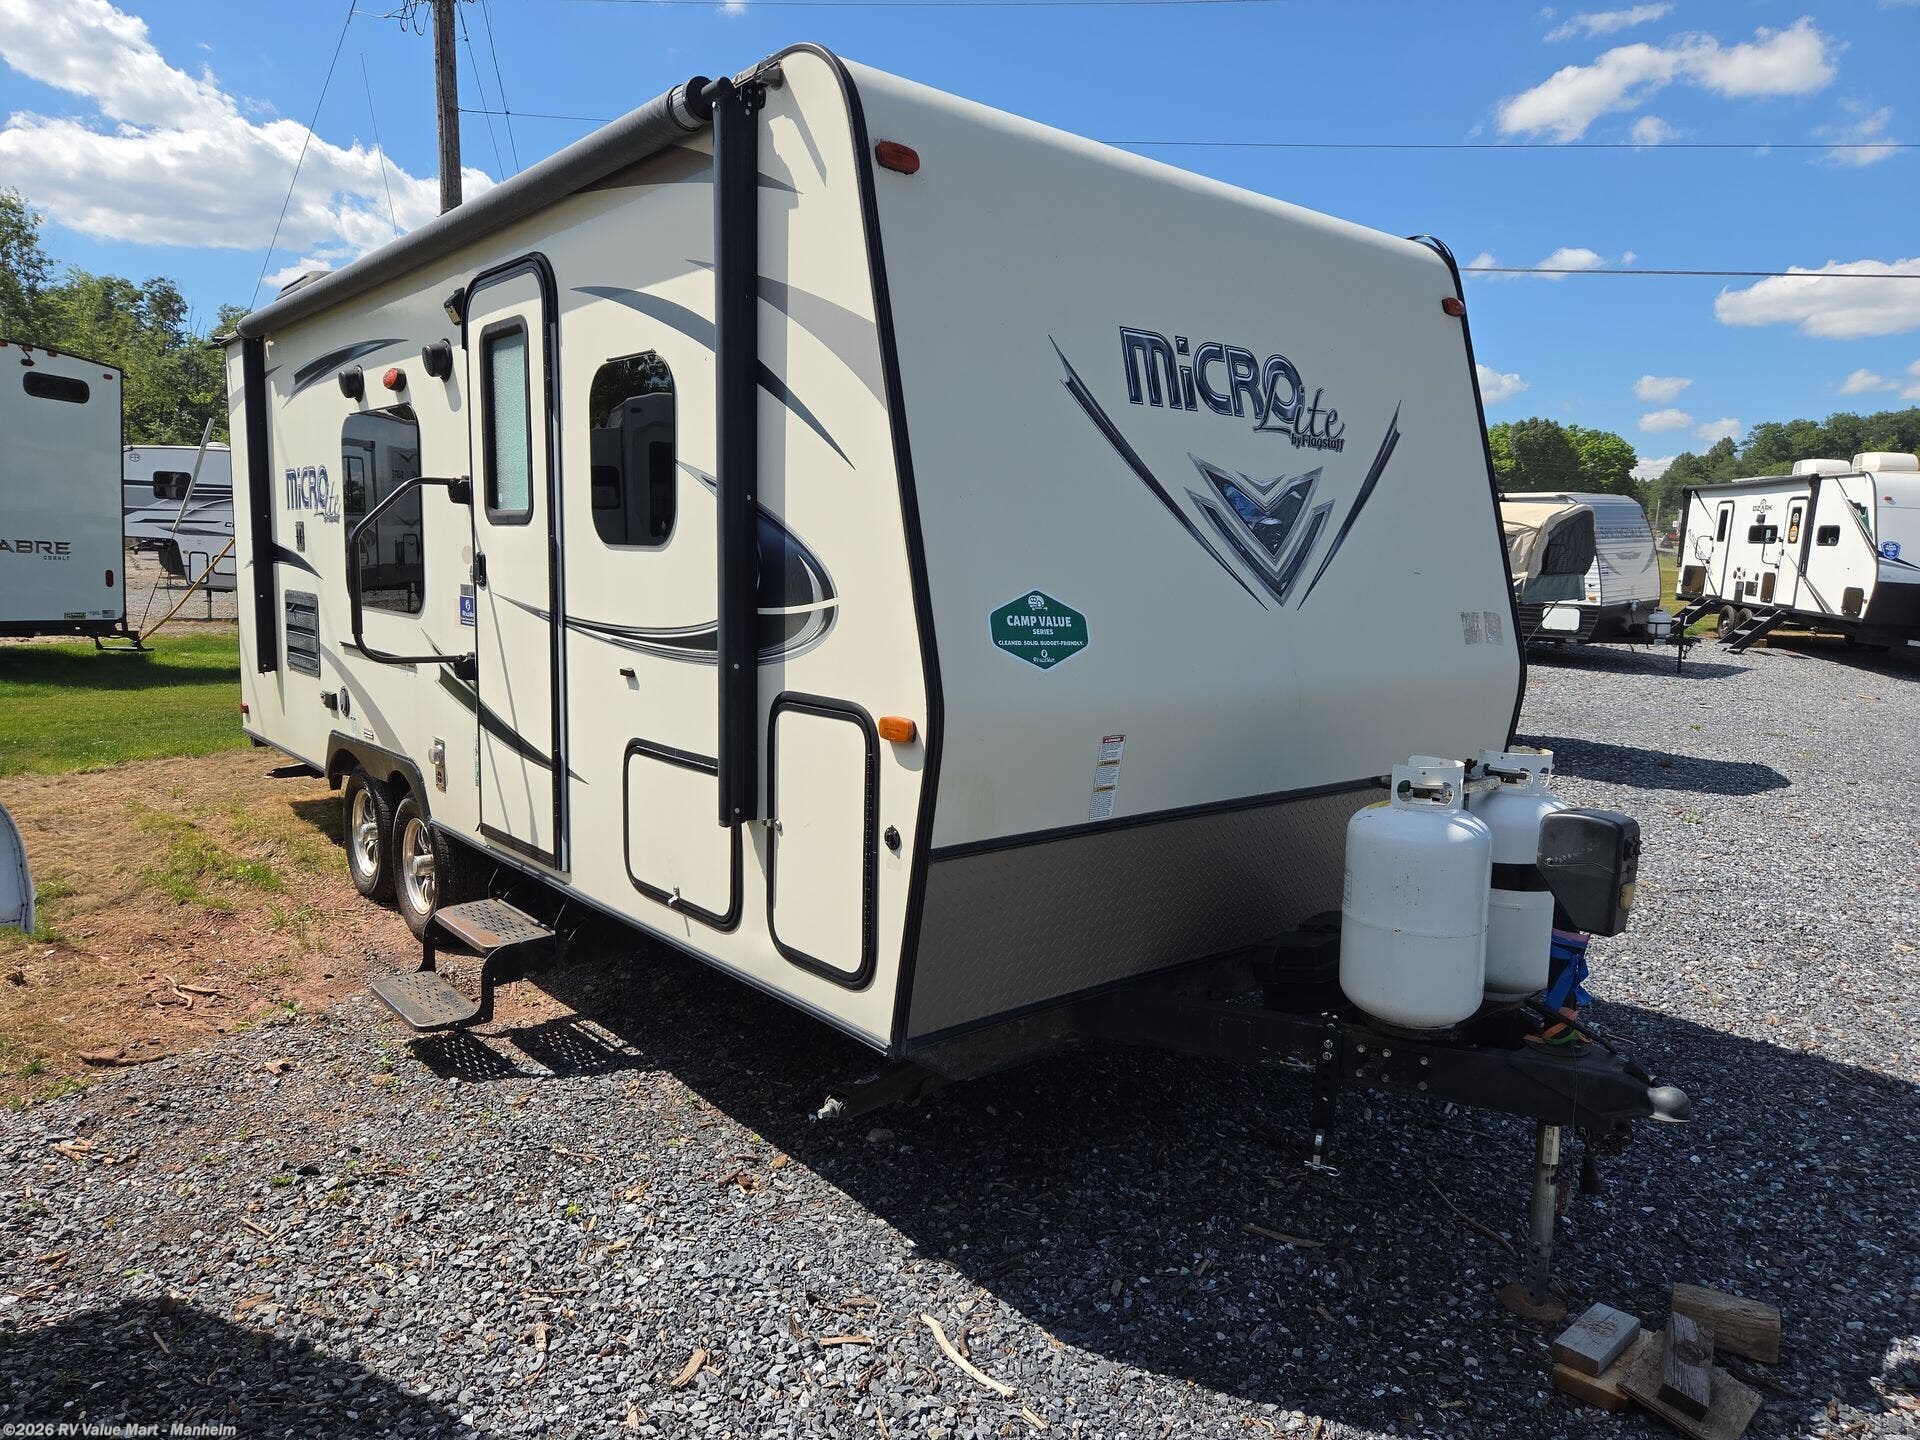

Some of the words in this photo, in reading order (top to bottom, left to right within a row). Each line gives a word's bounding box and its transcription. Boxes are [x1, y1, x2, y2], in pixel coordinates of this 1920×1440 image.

[1253, 372, 1345, 440] Lite
[1291, 433, 1301, 449] by
[1302, 434, 1345, 453] Flagstaff
[1006, 615, 1037, 627] CAMP
[1038, 615, 1072, 627] VALUE
